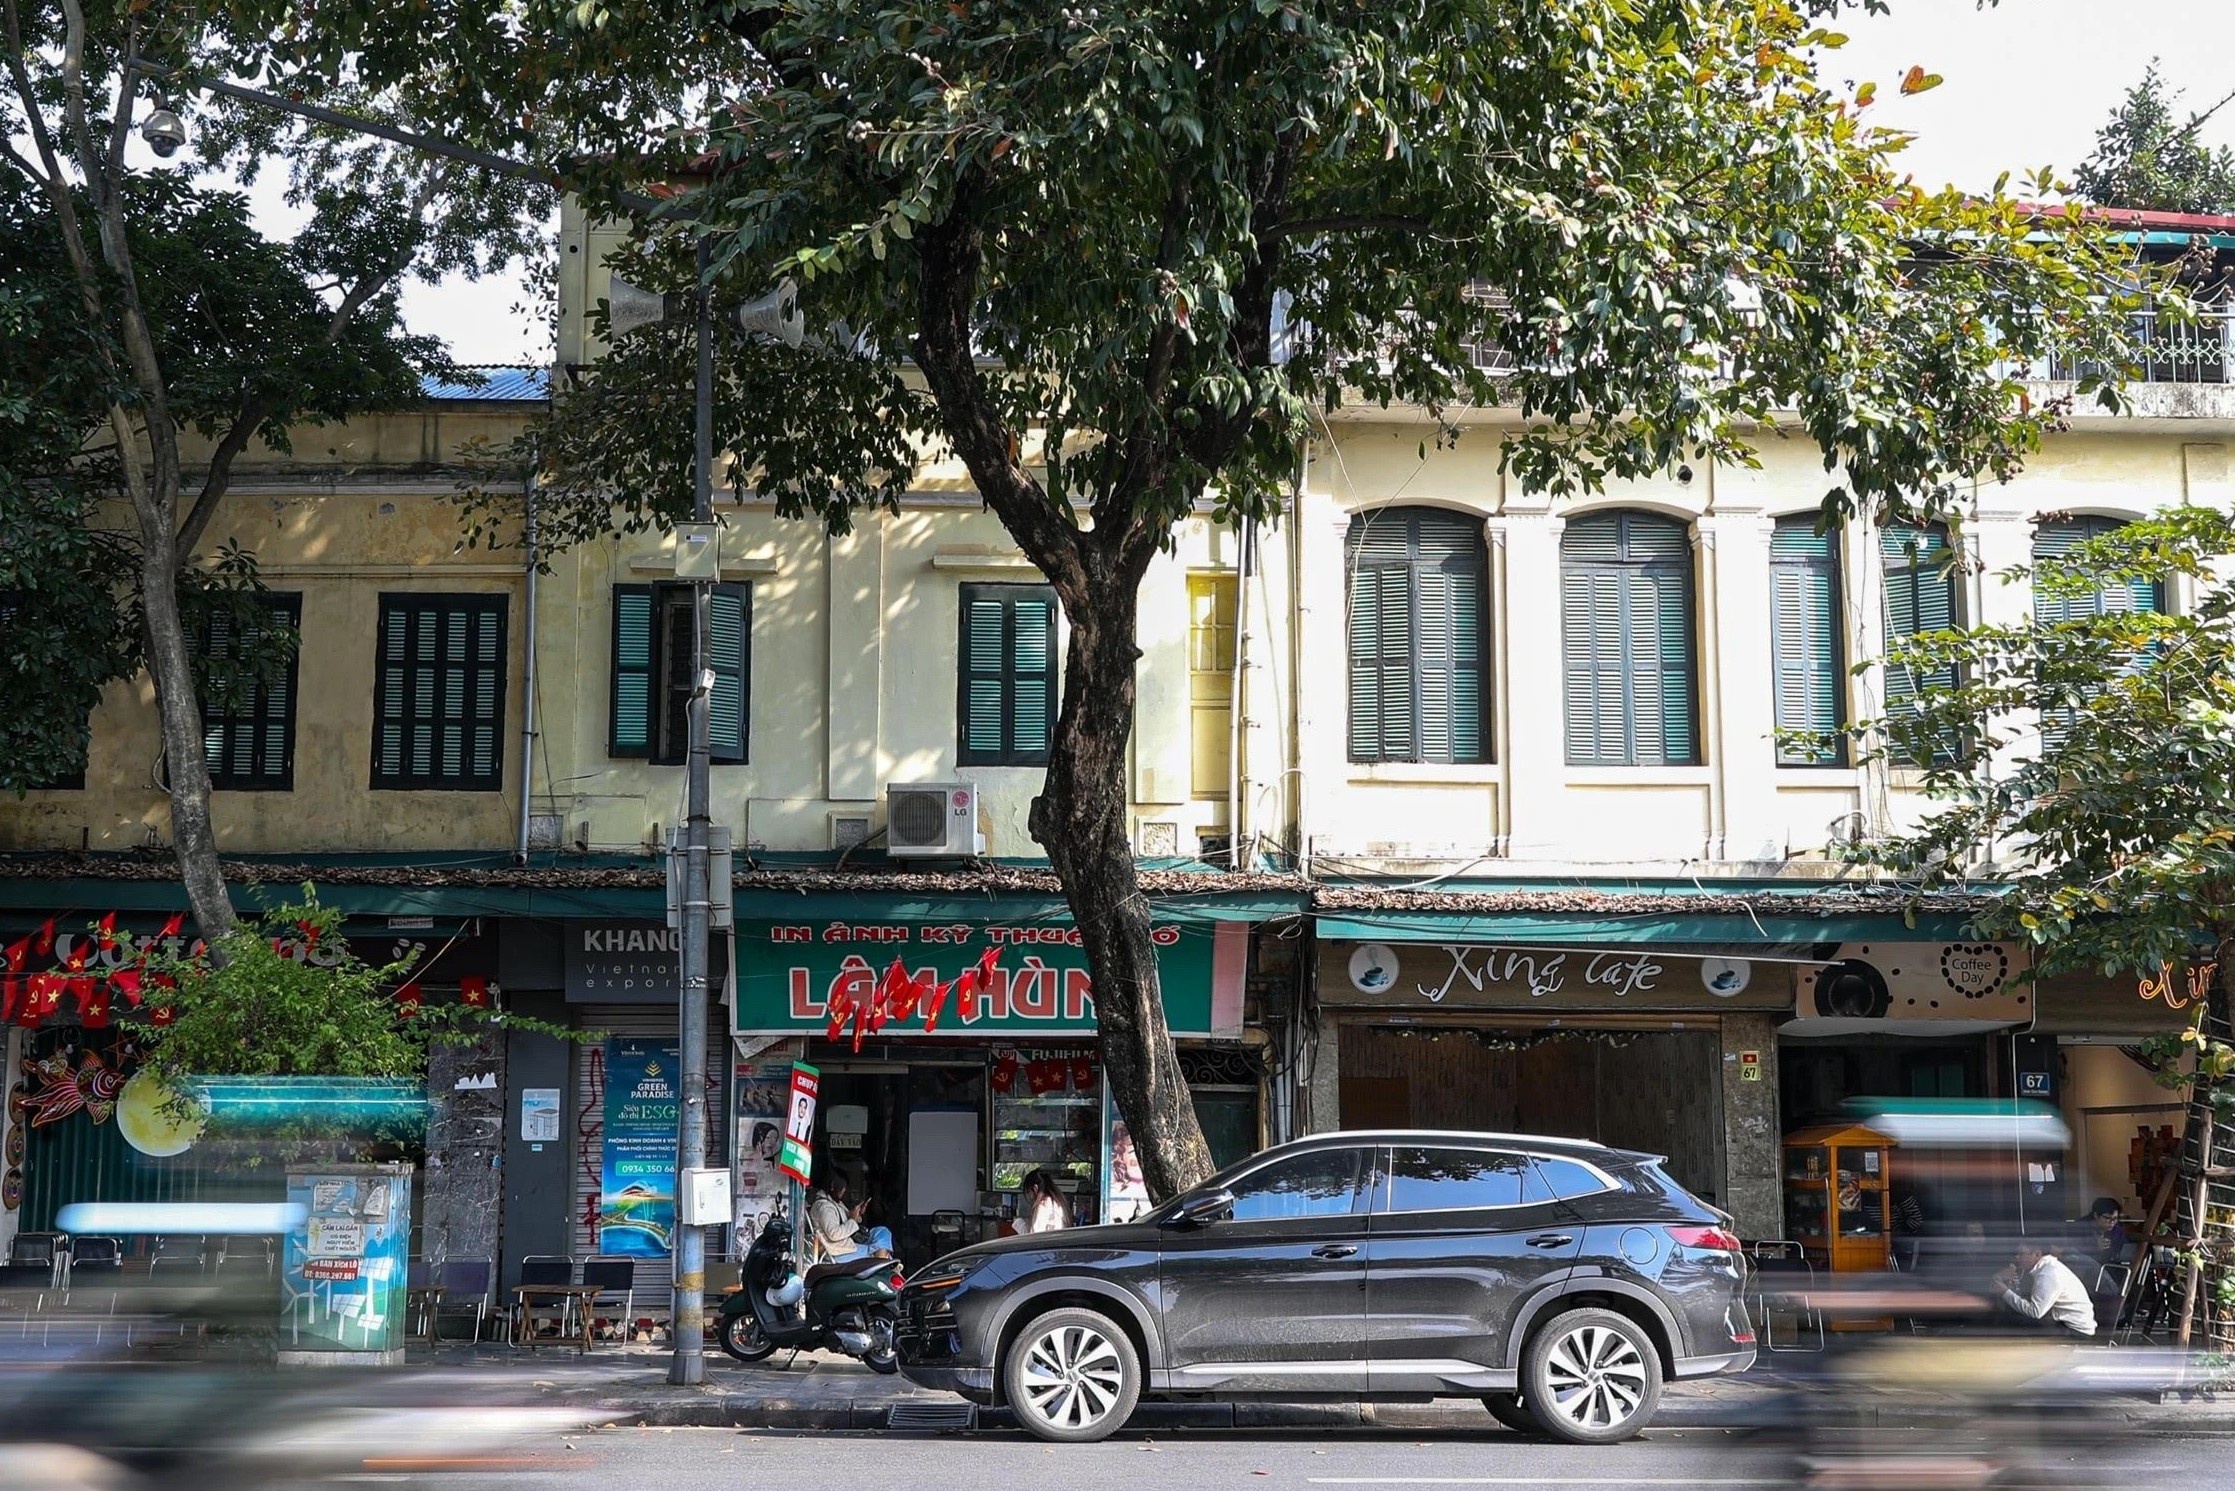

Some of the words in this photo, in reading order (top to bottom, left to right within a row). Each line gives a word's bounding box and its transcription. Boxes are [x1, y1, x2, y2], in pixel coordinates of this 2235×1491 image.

[954, 808, 967, 816] LG
[771, 926, 812, 943] IN
[822, 921, 909, 944] ẢNH
[920, 924, 973, 944] KỸ
[1952, 959, 1992, 970] Coffee
[1416, 946, 1566, 1002] Xing
[1961, 971, 1984, 985] Day
[961, 956, 1098, 1025] HÙN
[1743, 1067, 1756, 1078] 67
[637, 1083, 668, 1091] GREEN
[2026, 1075, 2044, 1088] 67
[630, 1091, 674, 1099] PARADISE
[622, 1165, 644, 1173] 0934
[646, 1165, 662, 1173] 350
